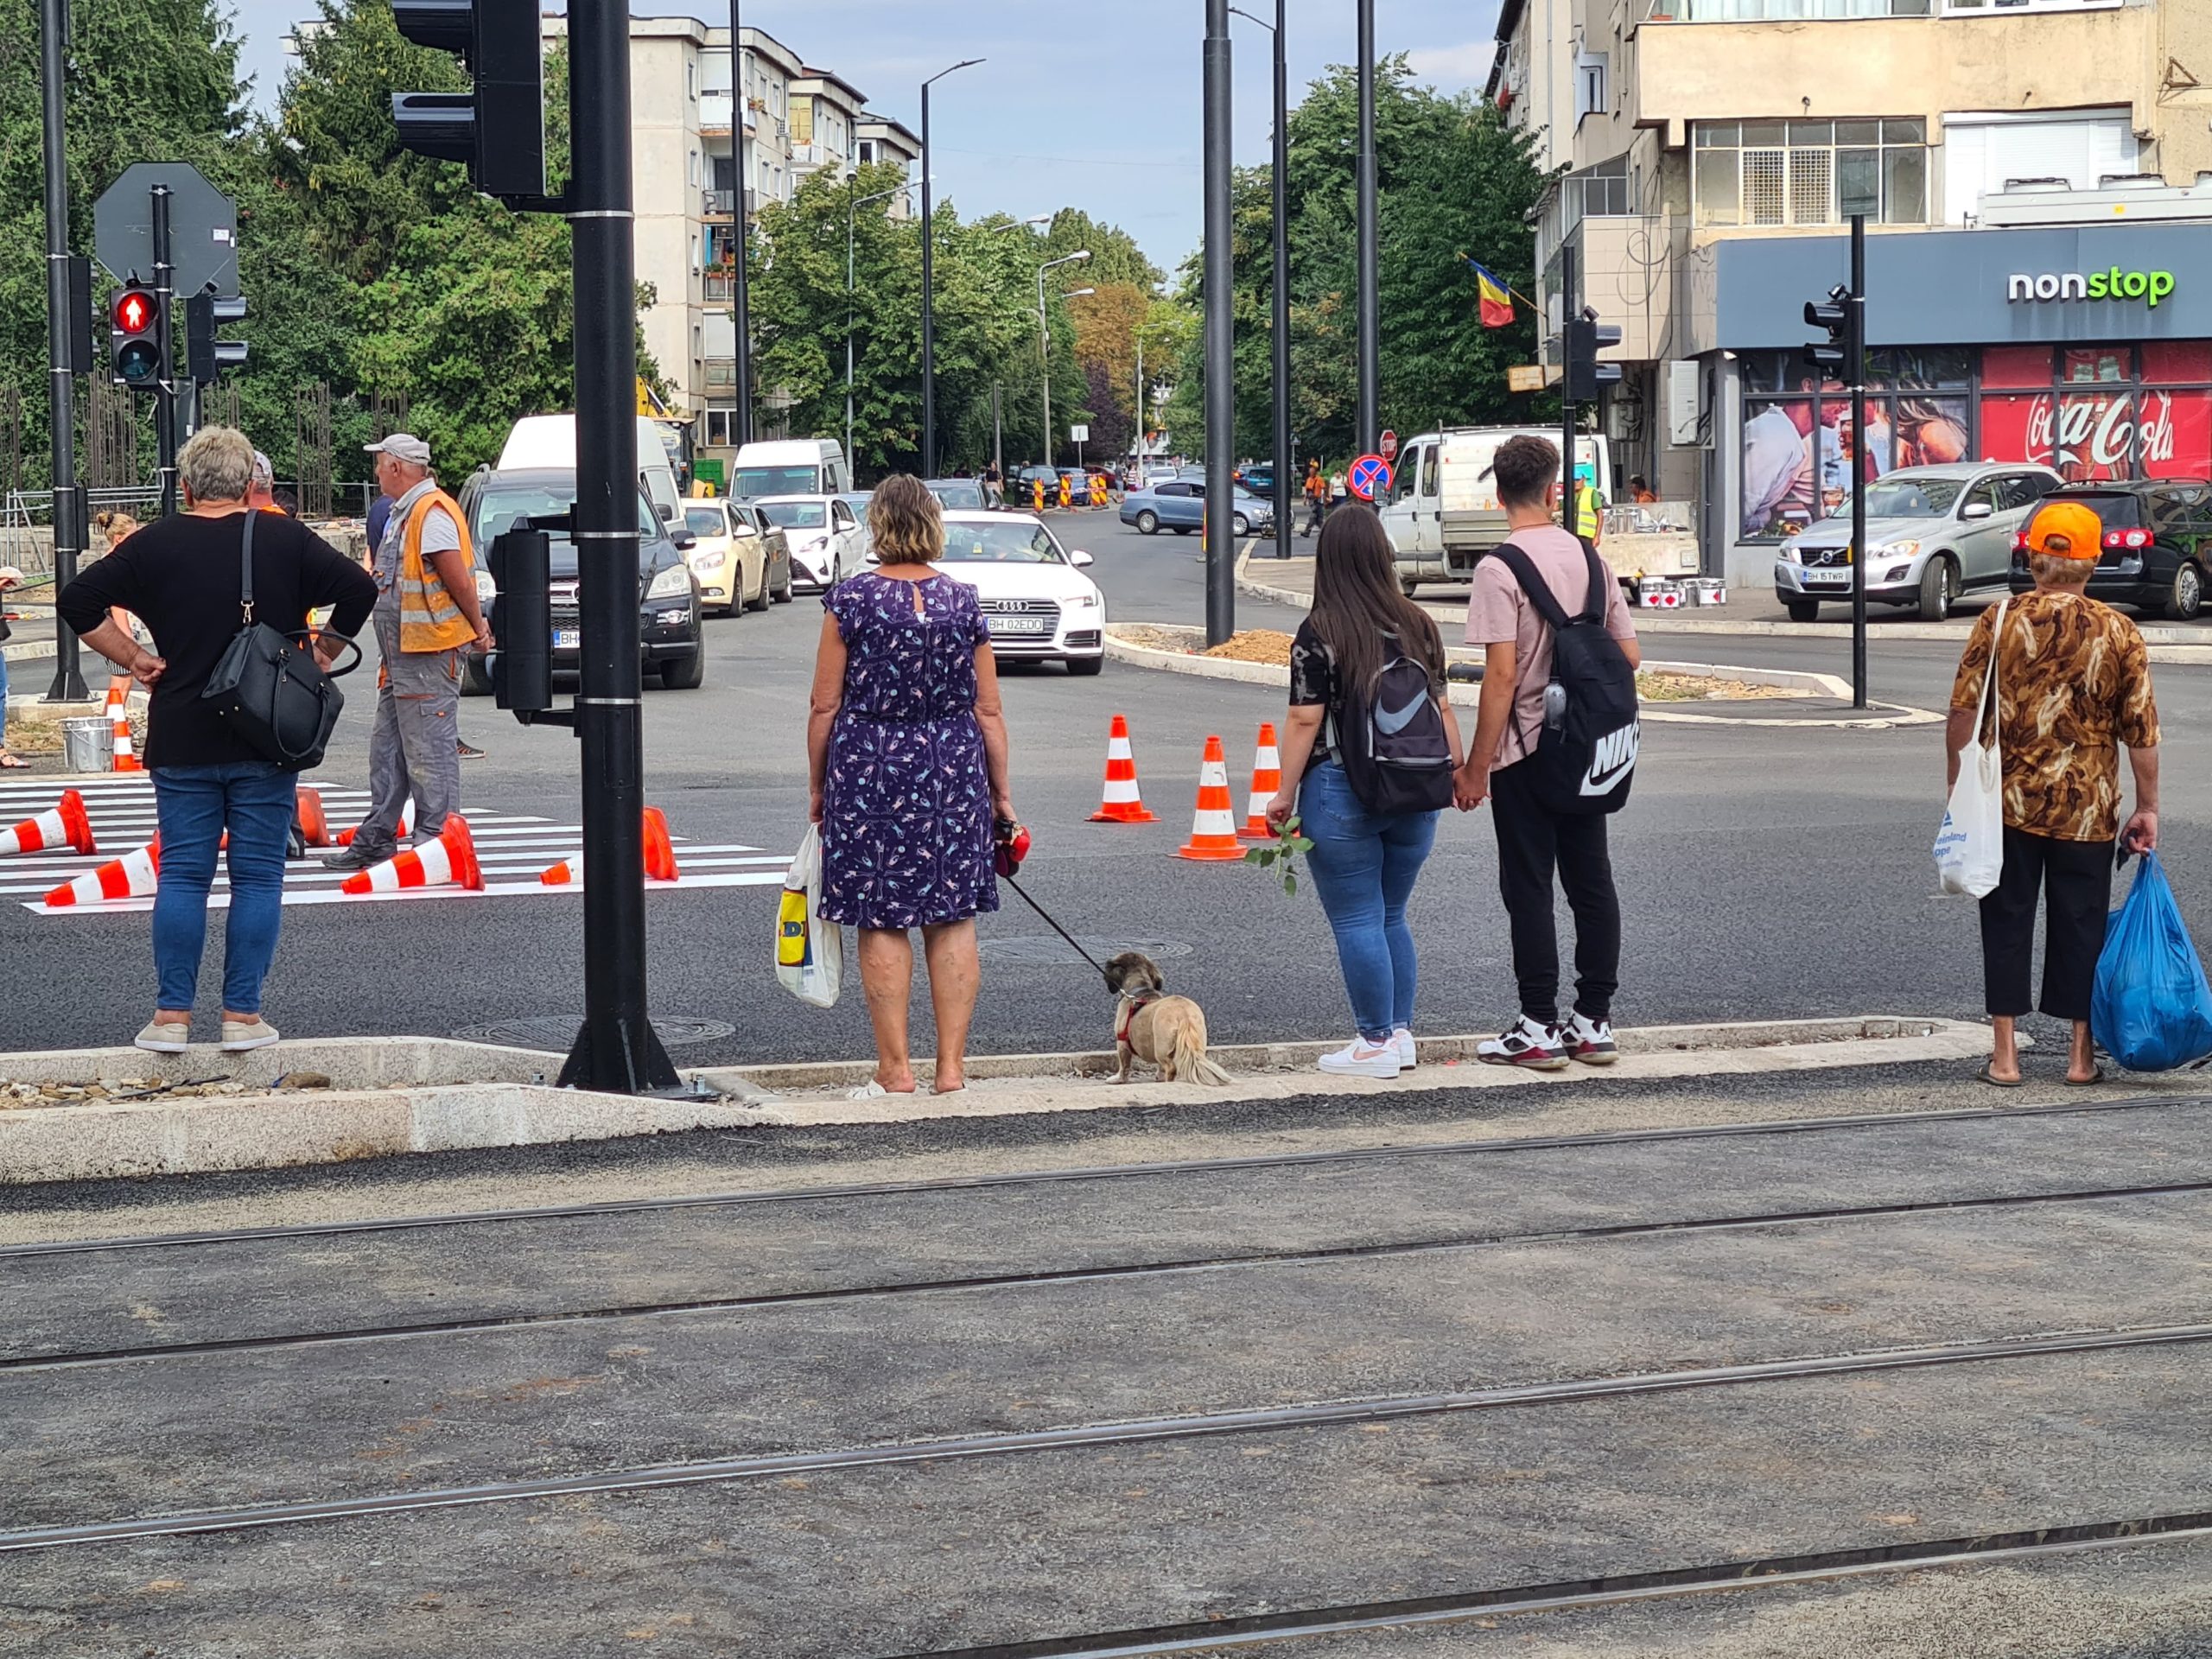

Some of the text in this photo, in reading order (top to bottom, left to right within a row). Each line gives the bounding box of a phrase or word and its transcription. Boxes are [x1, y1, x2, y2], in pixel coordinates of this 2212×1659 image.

[2008, 265, 2175, 306] nonstop
[2025, 389, 2174, 465] Coca-Cola
[1382, 439, 1395, 453] STOP
[988, 619, 1004, 630] BH
[562, 633, 578, 644] BH
[1936, 832, 1967, 844] einland
